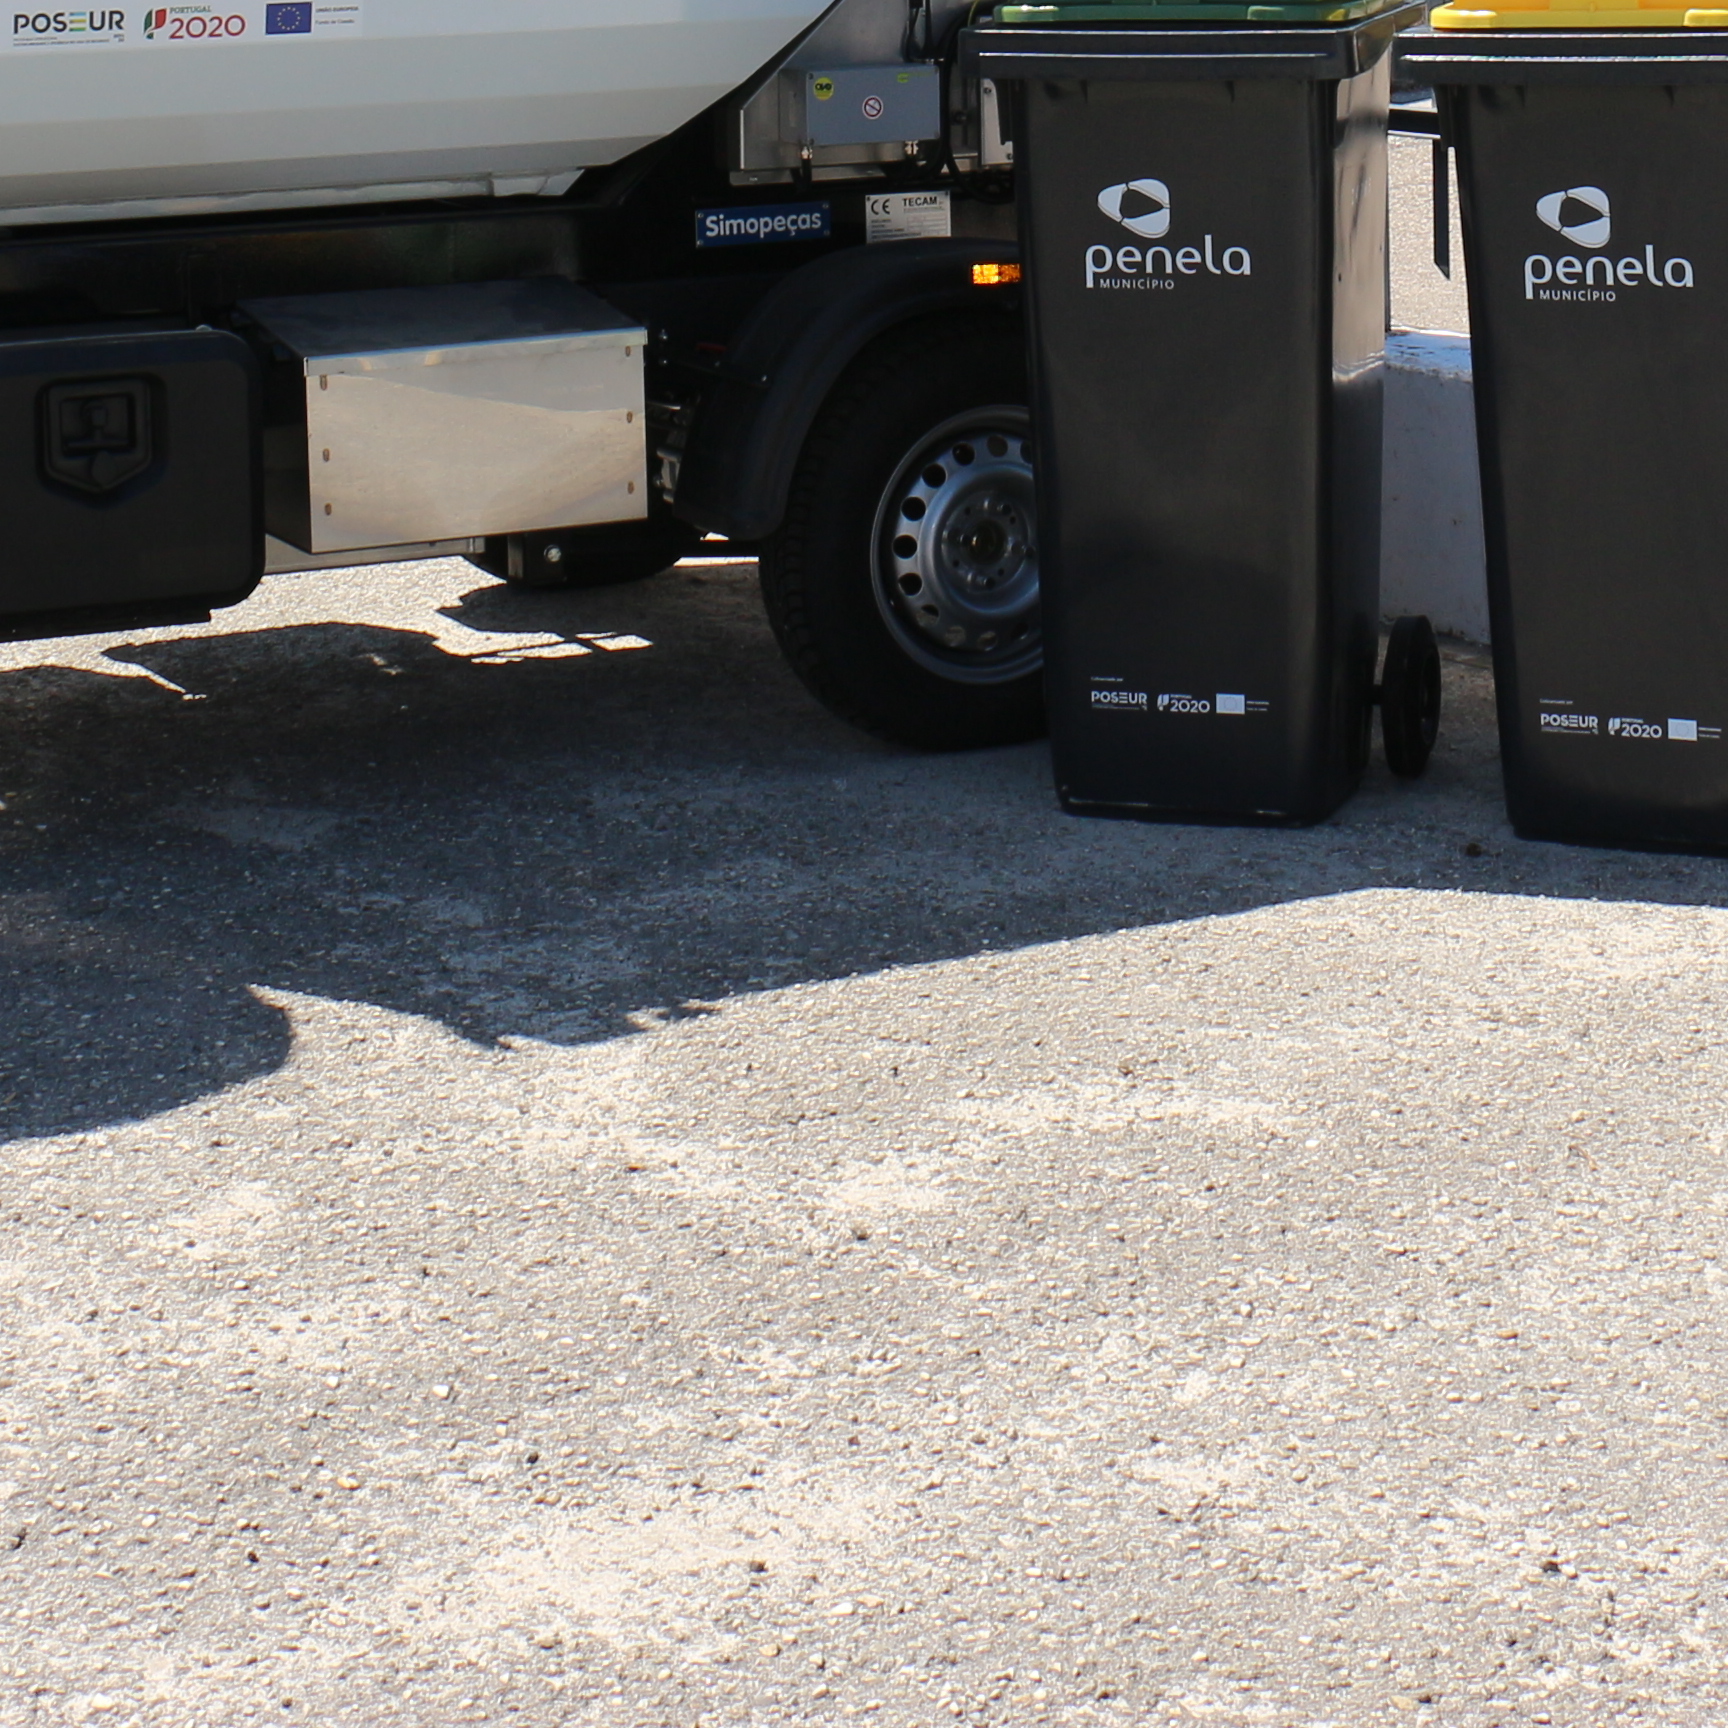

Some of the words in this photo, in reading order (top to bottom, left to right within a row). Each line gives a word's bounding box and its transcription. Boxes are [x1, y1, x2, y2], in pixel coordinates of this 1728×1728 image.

[13, 10, 125, 35] POSEUR
[169, 14, 246, 39] 2020
[902, 196, 938, 207] TECAM
[705, 211, 821, 238] Simopeças
[1085, 234, 1251, 288] penela
[1524, 244, 1694, 300] penela
[1099, 277, 1174, 290] MUNICÍPIO
[1540, 288, 1616, 302] MUNICÍPIO
[1091, 691, 1148, 704] POSEUR
[1170, 699, 1210, 713] 2020
[1540, 713, 1598, 728] POSEUR
[1621, 723, 1662, 738] 2020
